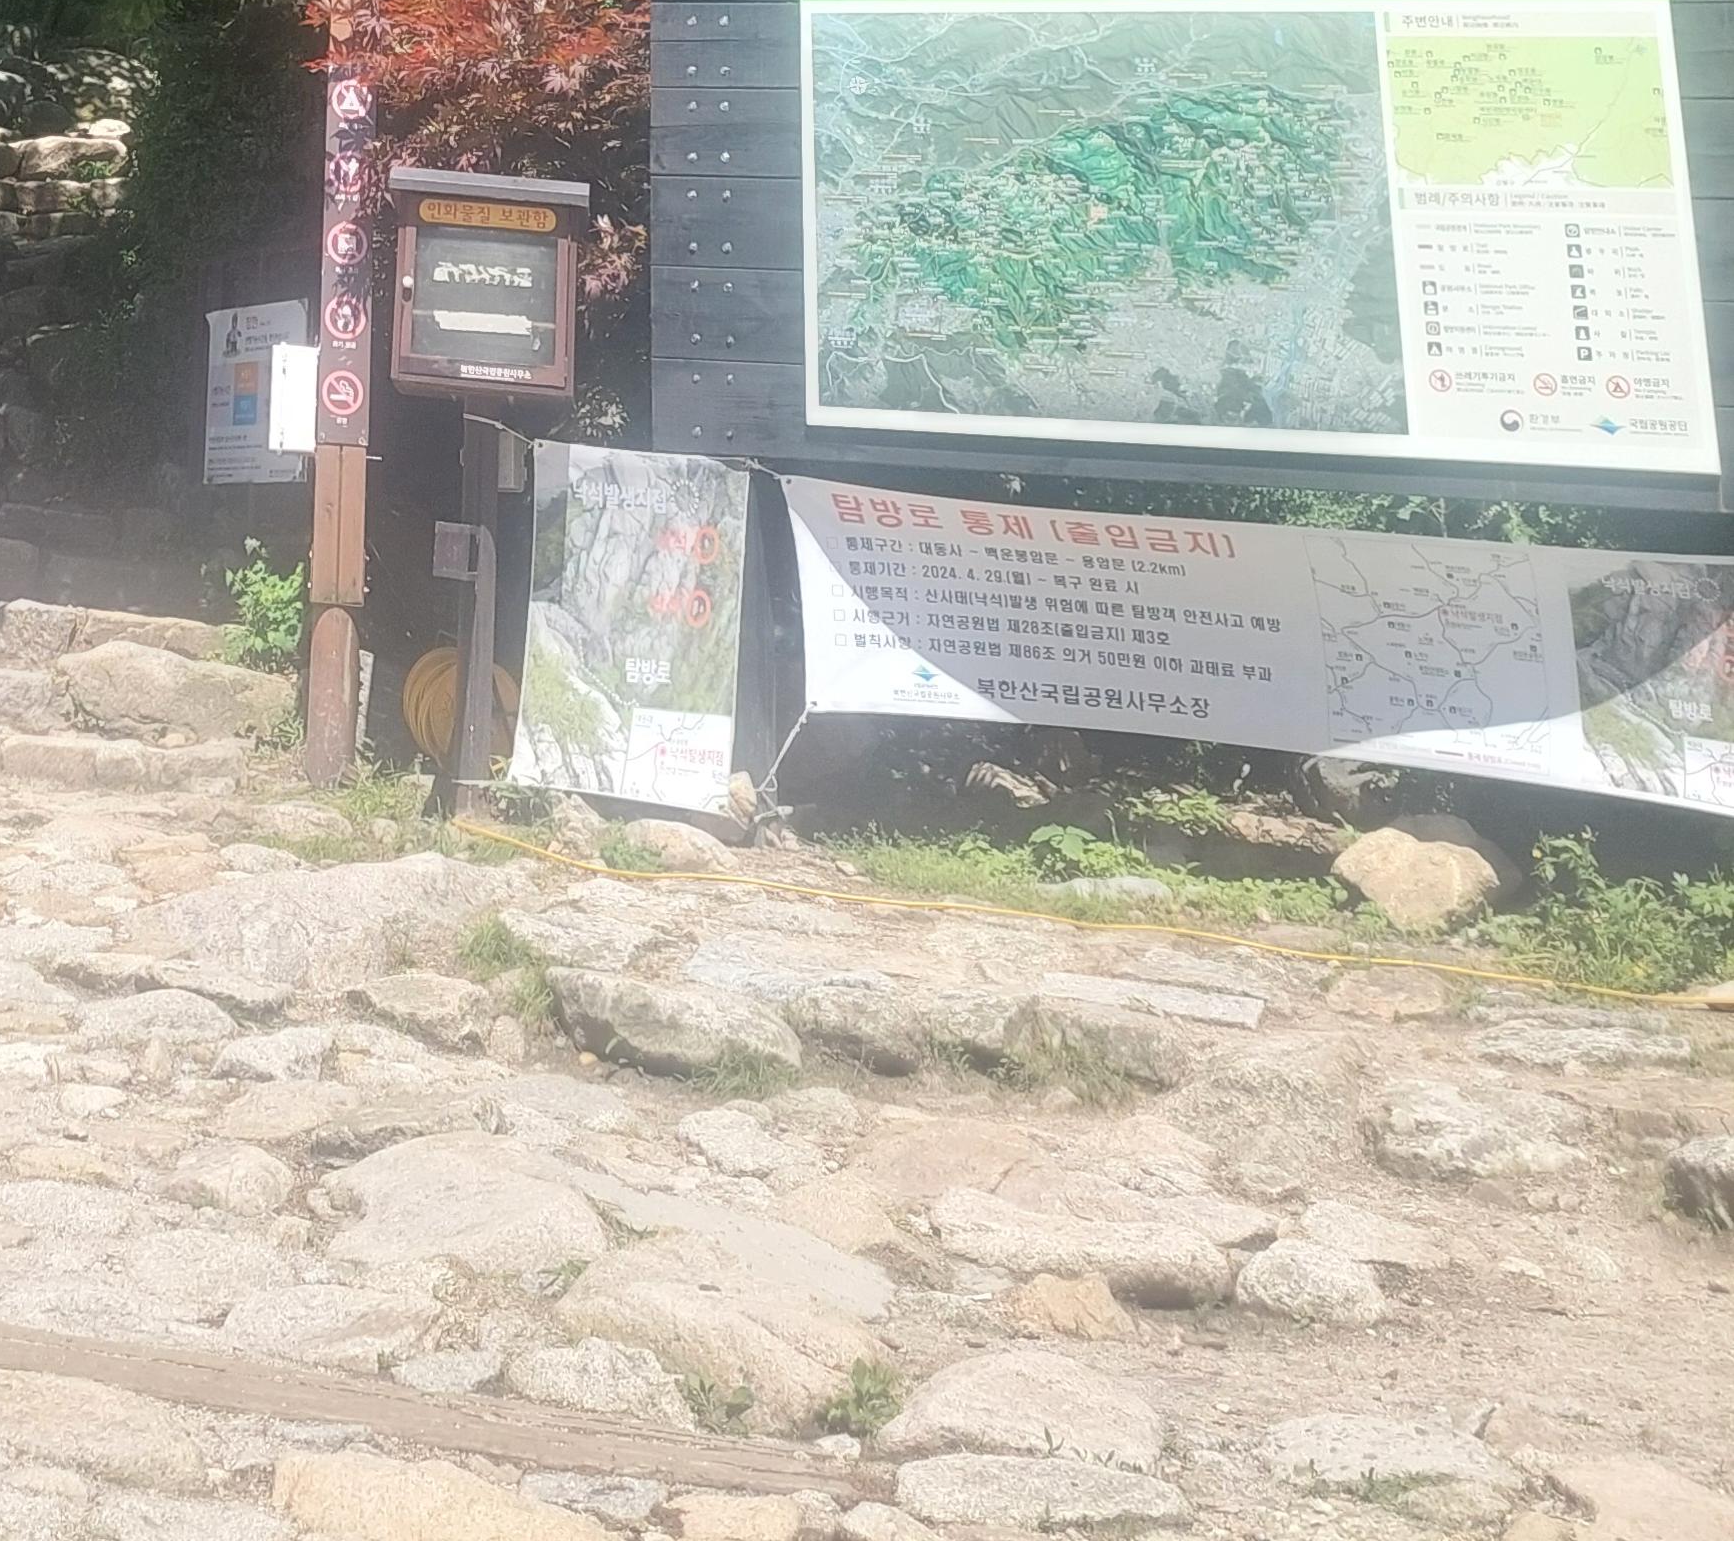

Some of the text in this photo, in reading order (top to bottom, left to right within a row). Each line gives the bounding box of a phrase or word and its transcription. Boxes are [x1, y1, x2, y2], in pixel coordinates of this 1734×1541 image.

[1402, 15, 1454, 29] 주변안내
[1415, 192, 1500, 207] 범례/주의사항
[427, 202, 550, 230] 인화물질 보관함
[1628, 418, 1689, 433] 국립공원공단
[572, 480, 668, 515] 낙석발생지점
[831, 493, 945, 530] 탐방로
[960, 509, 1035, 541] 통제
[846, 535, 903, 553] 통제구간
[919, 542, 962, 558] 대동사
[985, 547, 1059, 566] 백운봉암문
[1082, 555, 1126, 572] 용암문
[849, 560, 907, 578] 통제기간
[922, 564, 963, 580] 2024.
[967, 567, 980, 582] 4.
[1054, 575, 1083, 591] 복구
[1089, 577, 1119, 594] 완료
[1125, 581, 1140, 595] 시
[1601, 576, 1691, 600] 낙석발생지점
[851, 585, 909, 602] 시행목적
[1045, 597, 1089, 615] 위험에
[1095, 601, 1126, 618] 따른
[1132, 604, 1177, 623] 탐방객
[1183, 609, 1245, 629] 안전사고
[1250, 615, 1282, 634] 예방
[853, 609, 911, 627] 시행근거
[927, 613, 1000, 633] 자연공원법
[1132, 628, 1171, 646] 제3호
[625, 657, 671, 685] 탐방로
[854, 633, 912, 650] 벌칙사항
[929, 637, 1002, 657] 자연공원법
[1008, 643, 1056, 661] 제86조
[1063, 647, 1092, 665] 의거
[1098, 651, 1146, 669] 50만원
[1153, 655, 1183, 673] 이하
[1190, 659, 1235, 678] 과태료
[1242, 664, 1273, 683] 부과
[977, 678, 1211, 719] 북한산국립공원사무소장
[1668, 698, 1714, 724] 탐방로
[670, 749, 724, 767] 낙석발생지점
